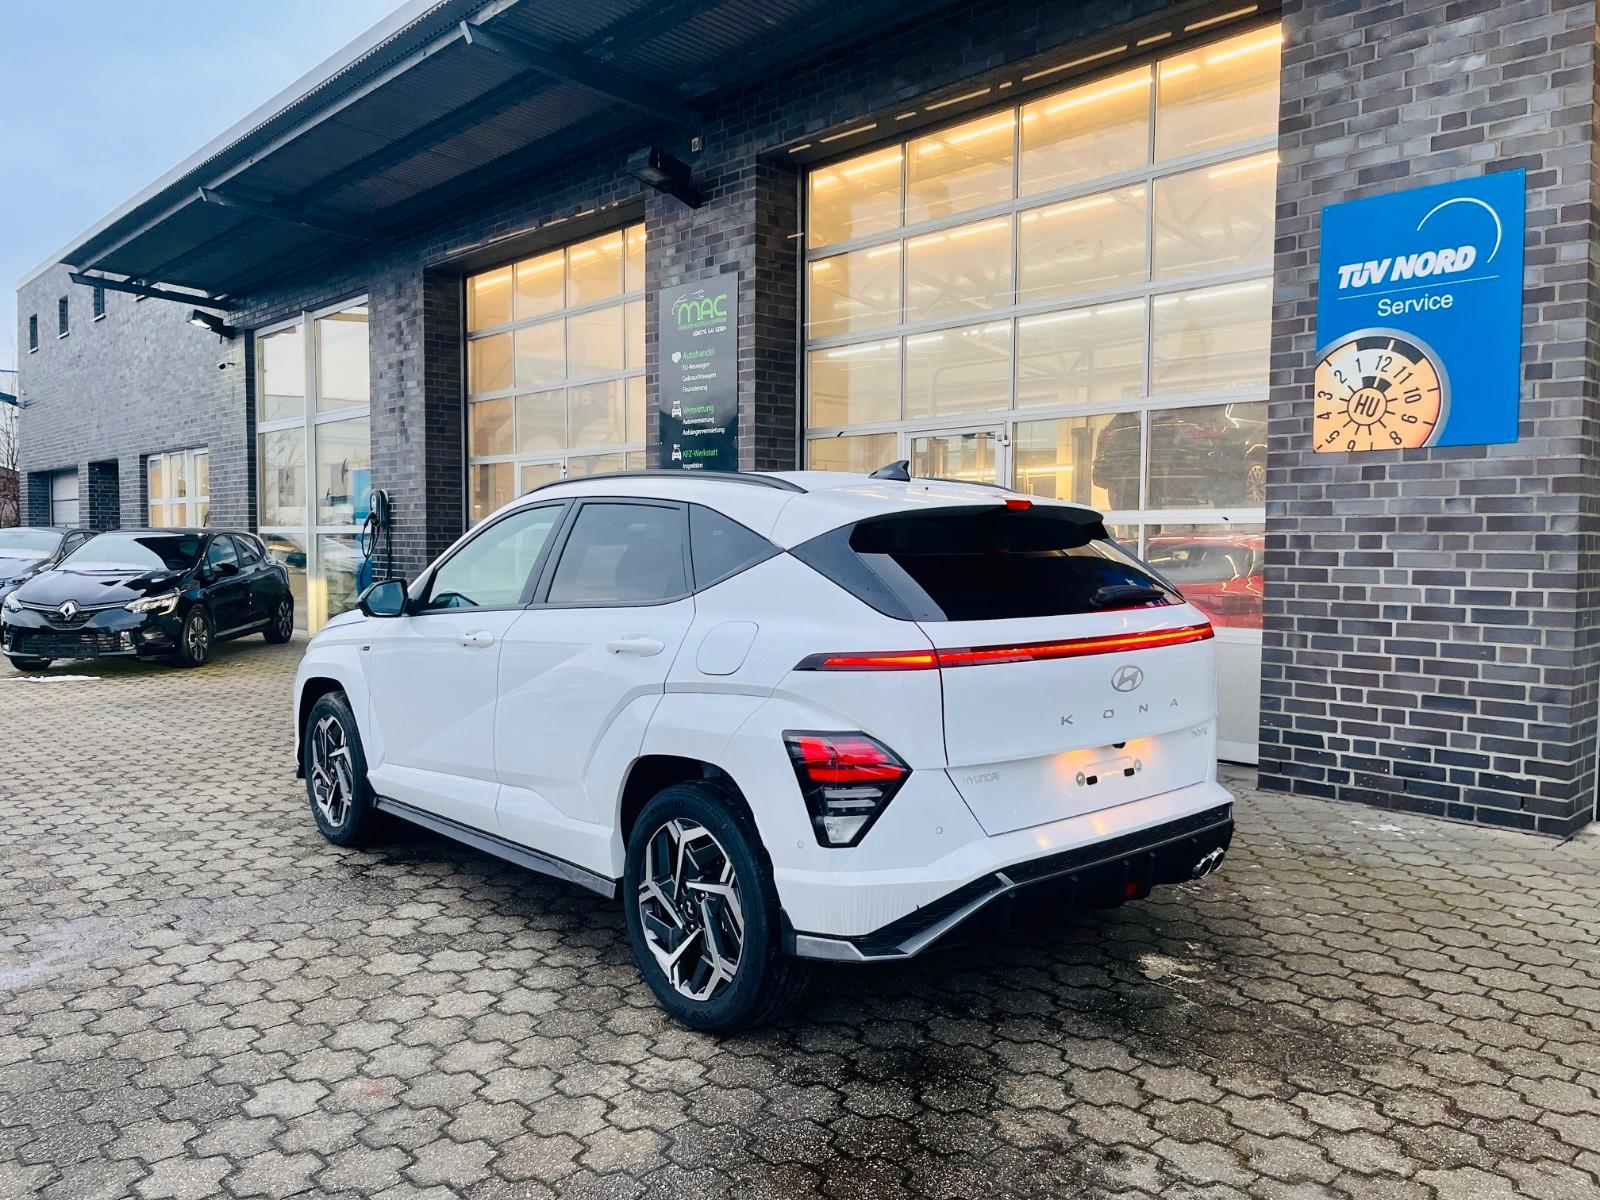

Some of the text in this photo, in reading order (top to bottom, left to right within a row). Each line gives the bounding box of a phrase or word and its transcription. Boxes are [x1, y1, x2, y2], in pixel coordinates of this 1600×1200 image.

[1338, 245, 1477, 289] TÜV NORD
[678, 294, 728, 325] MAC
[1377, 293, 1453, 317] Service
[683, 348, 716, 360] Autohandel
[1354, 357, 1362, 373] 1
[1375, 355, 1393, 373] 12
[1333, 369, 1348, 384] 2
[1393, 366, 1413, 385] 11
[1317, 390, 1333, 400] 3
[1403, 386, 1422, 404] 10
[1353, 393, 1381, 418] HU
[1316, 411, 1332, 420] 4
[1325, 430, 1340, 444] 5
[1388, 430, 1403, 445] 8
[683, 448, 719, 458] KFZ-Werkstatt
[683, 462, 704, 470] Inspektion
